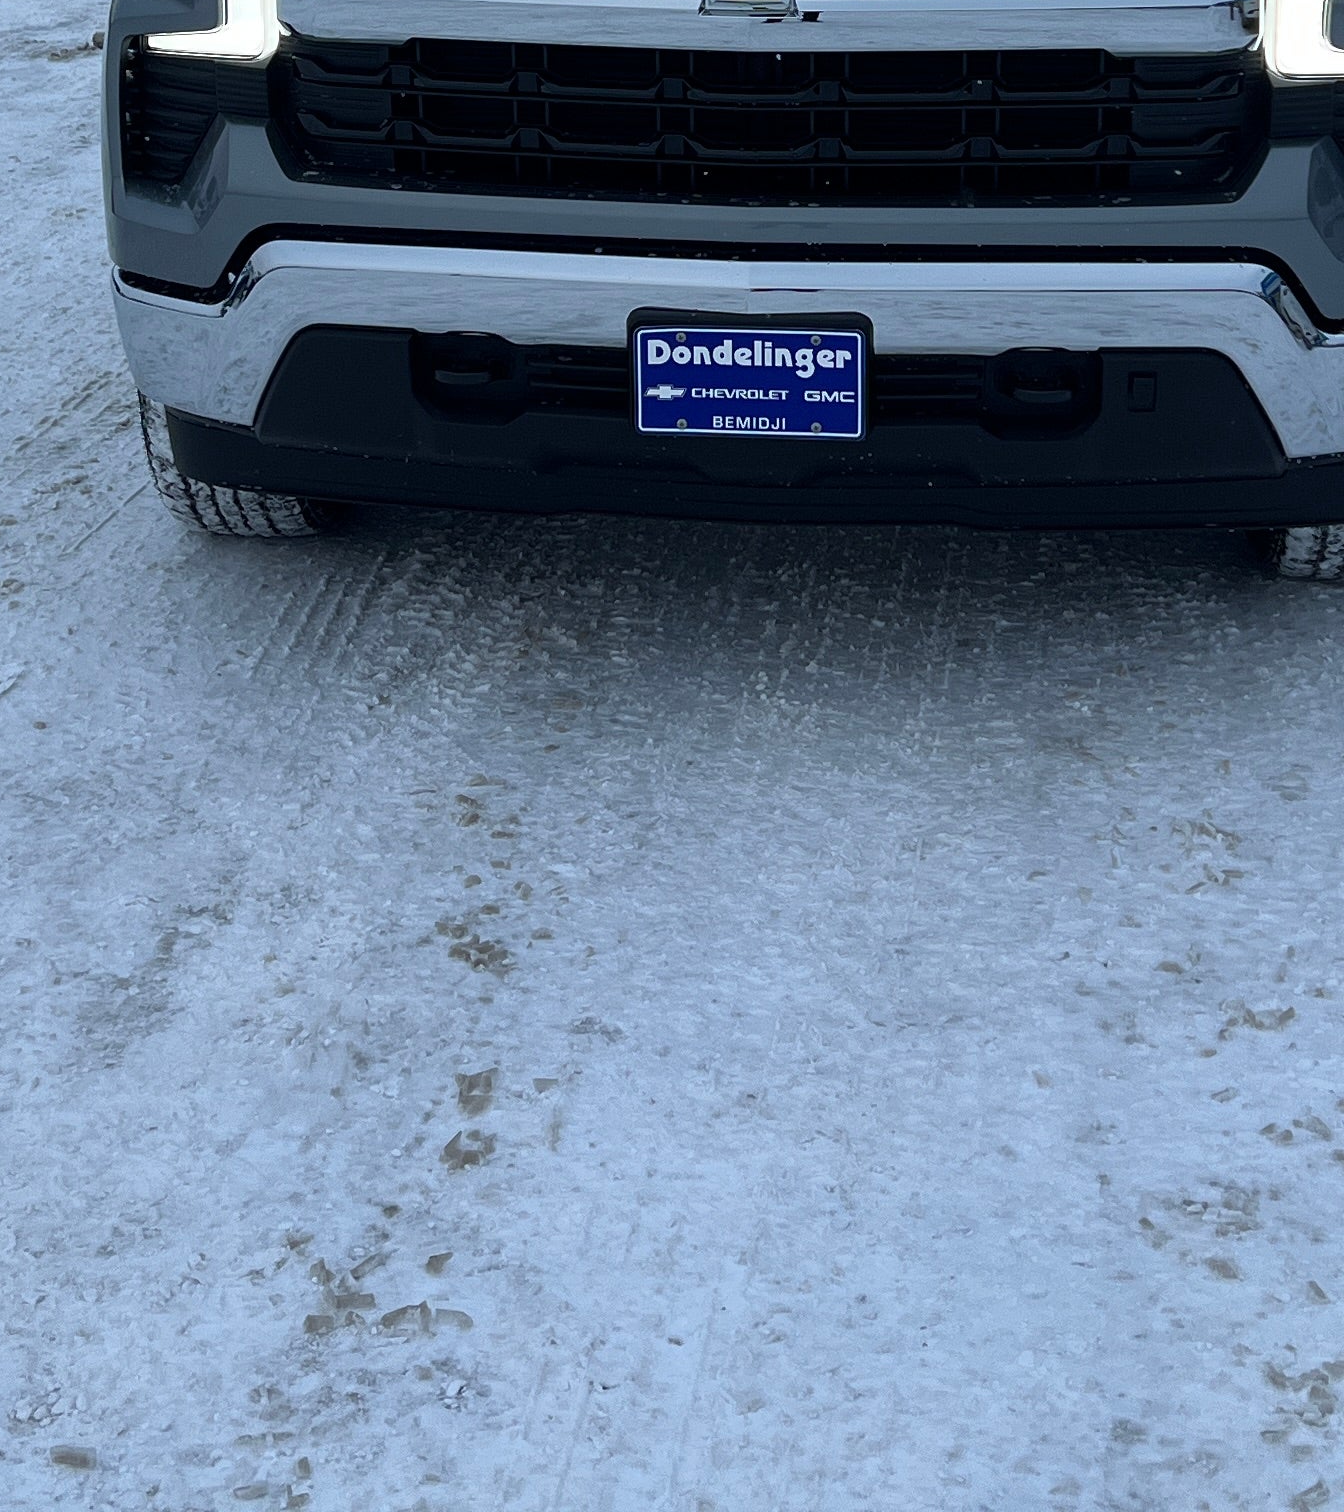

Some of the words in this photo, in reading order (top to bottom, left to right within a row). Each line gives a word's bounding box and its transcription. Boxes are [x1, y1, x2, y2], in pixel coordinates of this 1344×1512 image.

[647, 339, 852, 379] Dondelinger
[691, 388, 790, 401] CHEVROLET
[804, 390, 855, 404] GMC
[712, 416, 787, 430] BEMIDJI
